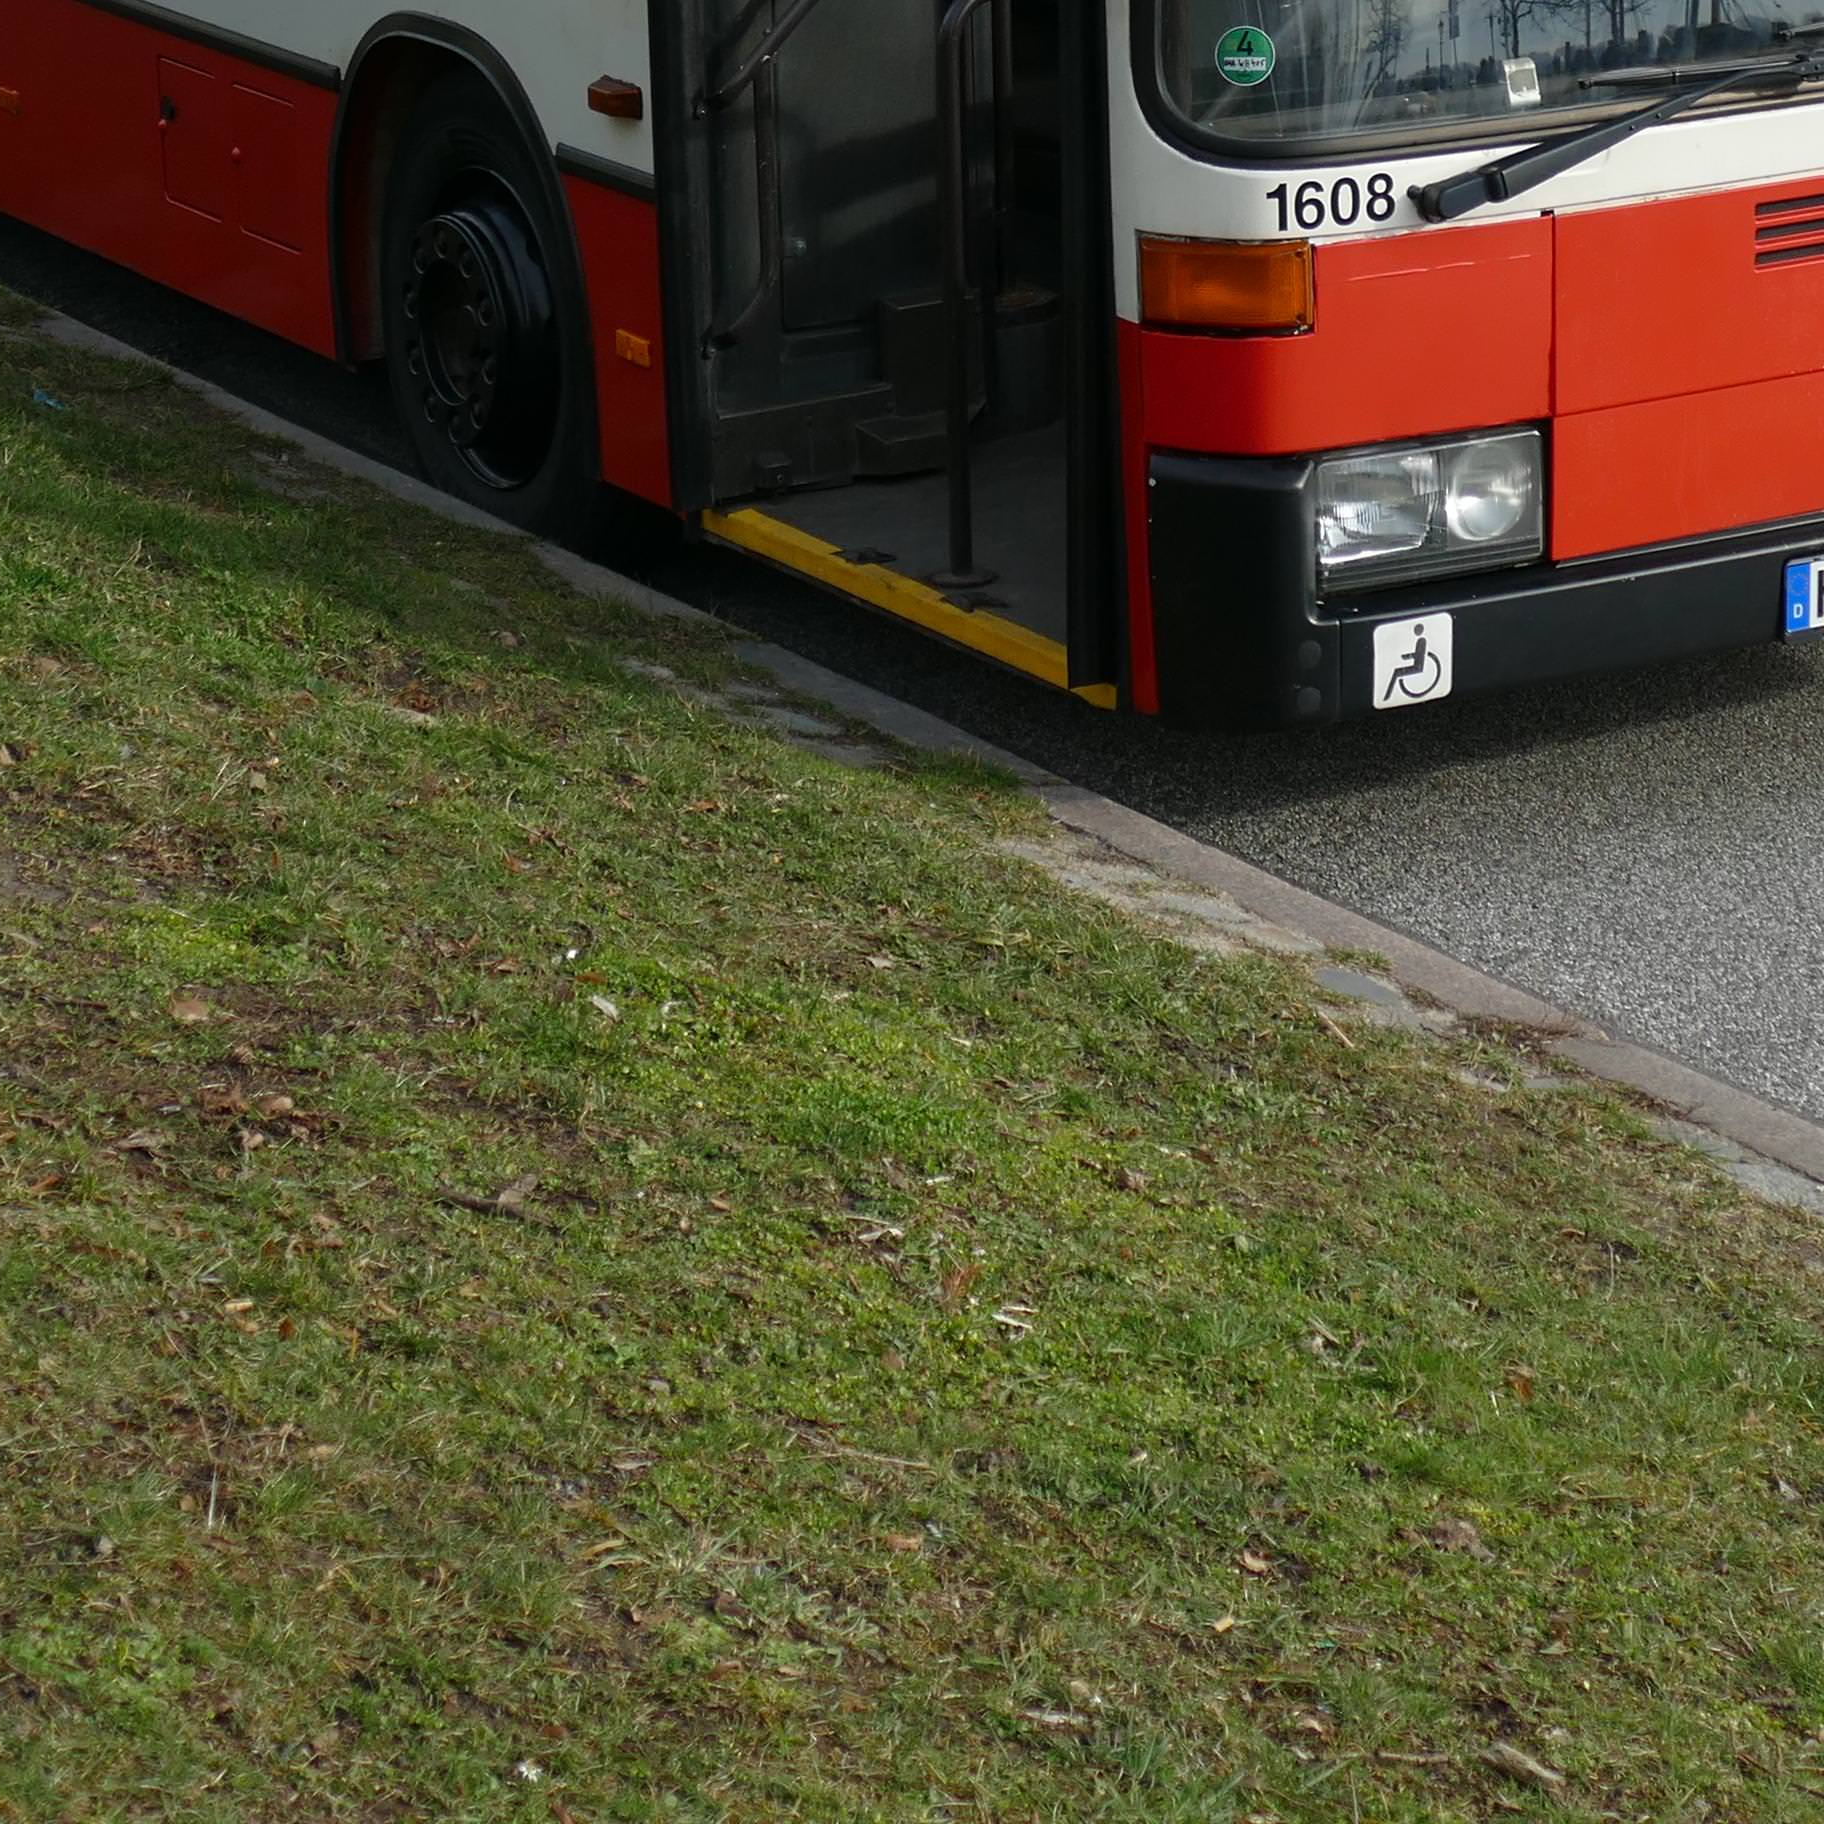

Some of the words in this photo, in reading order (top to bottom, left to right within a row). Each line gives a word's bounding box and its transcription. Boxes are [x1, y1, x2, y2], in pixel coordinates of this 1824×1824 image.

[1237, 30, 1255, 56] 4
[1265, 172, 1396, 232] 1608
[1792, 603, 1804, 620] D
